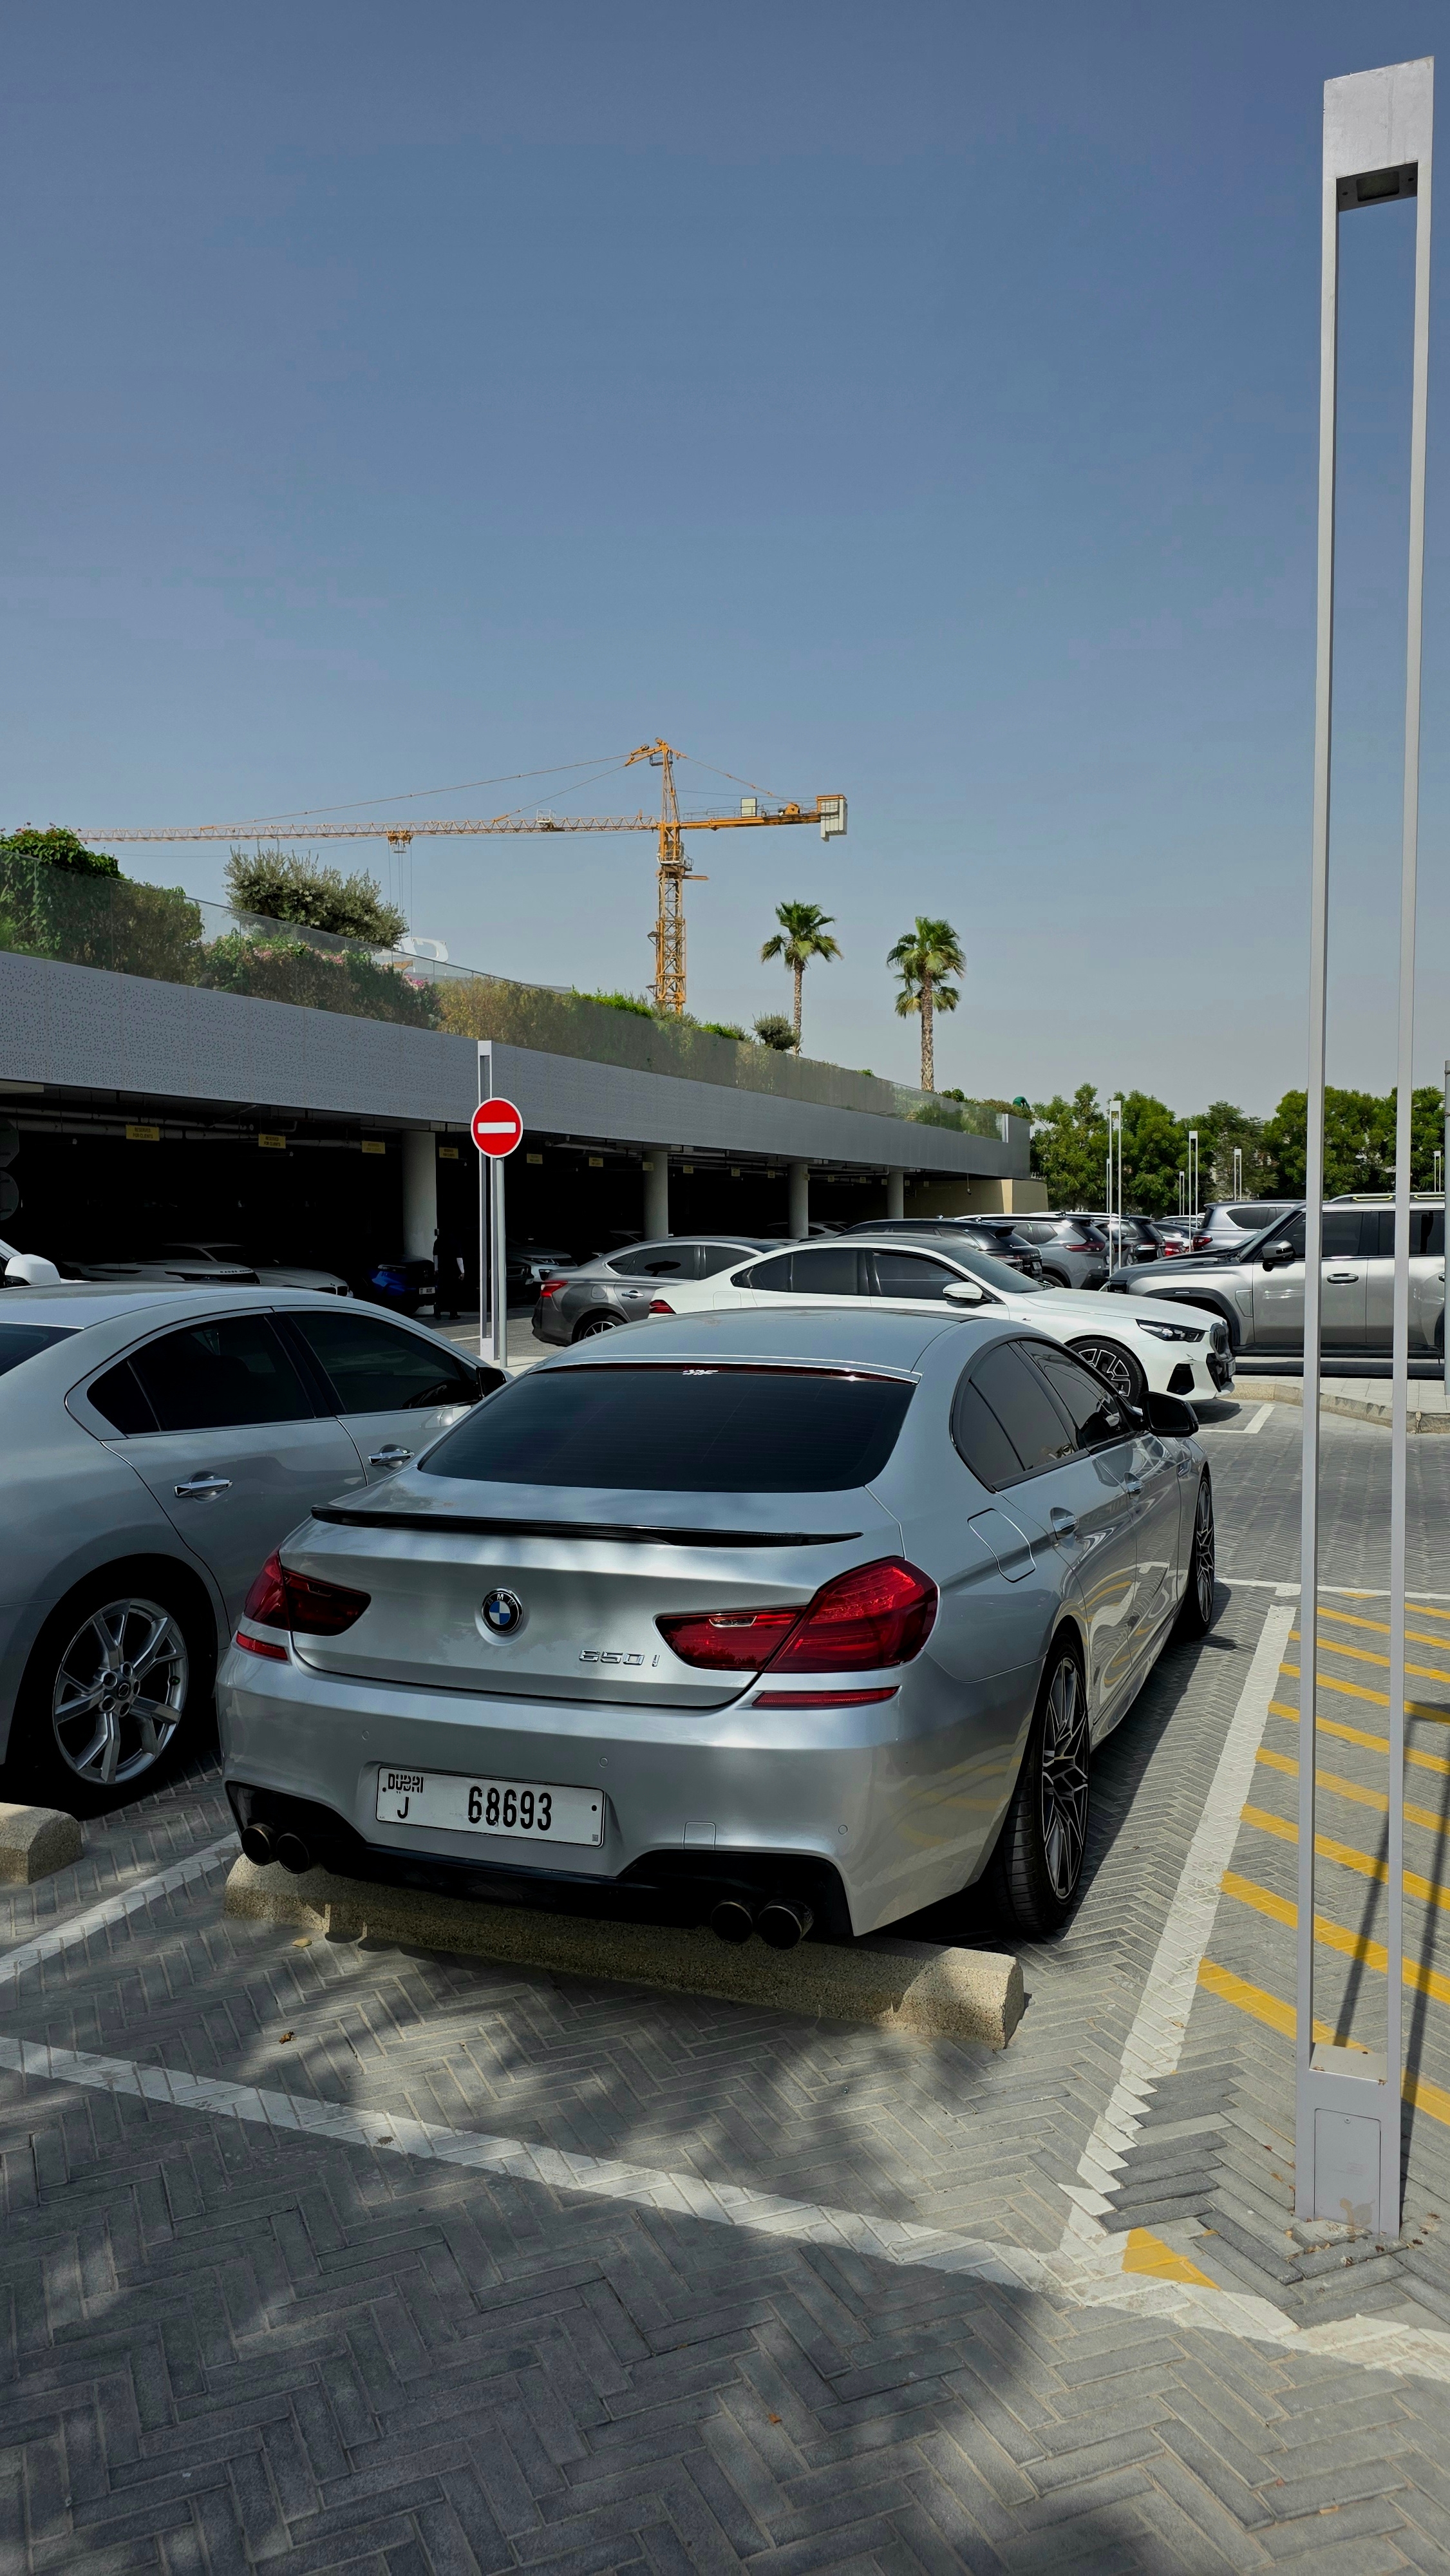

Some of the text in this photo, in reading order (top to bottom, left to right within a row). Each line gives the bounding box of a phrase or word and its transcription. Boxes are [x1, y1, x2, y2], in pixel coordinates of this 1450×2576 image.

[487, 1593, 516, 1607] BMW
[397, 1796, 410, 1819] J
[467, 1786, 552, 1831] 68693
